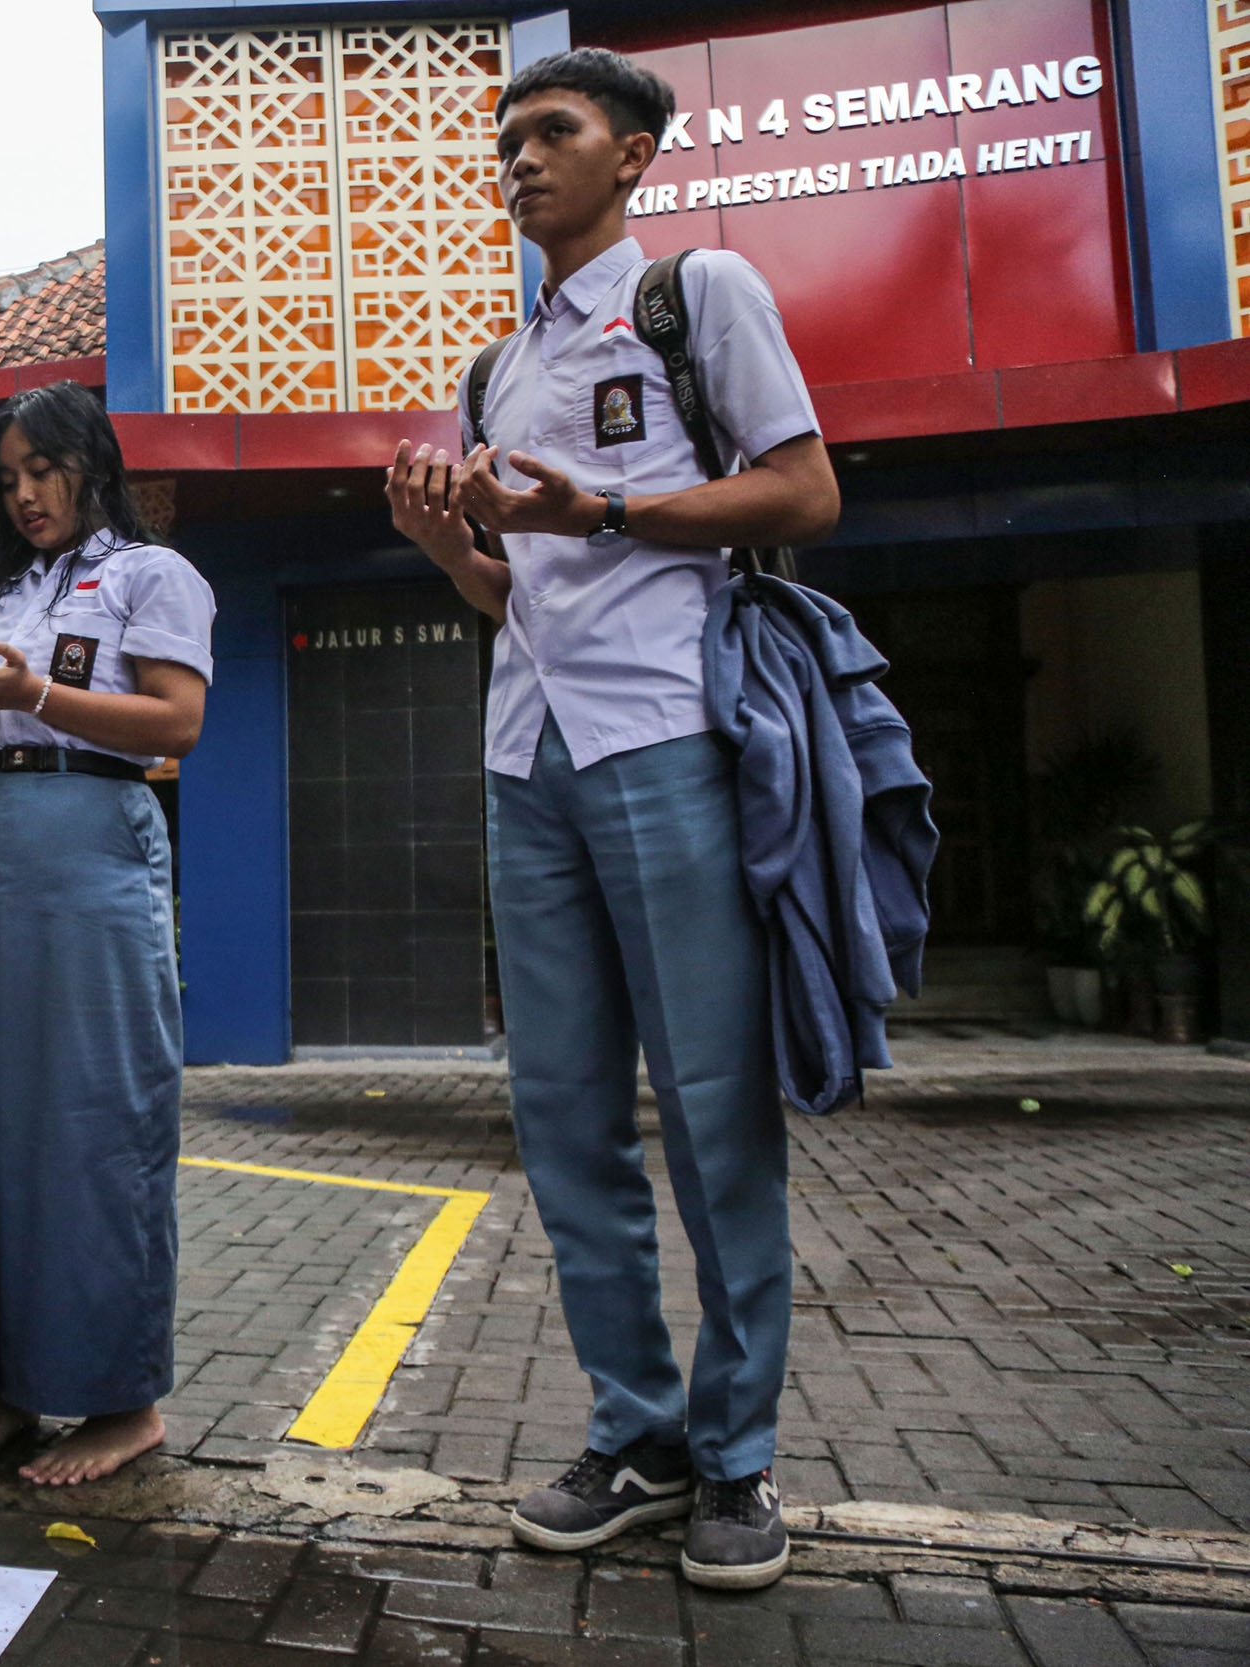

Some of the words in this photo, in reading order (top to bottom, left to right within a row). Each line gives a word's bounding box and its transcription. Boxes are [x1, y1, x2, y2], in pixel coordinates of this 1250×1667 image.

[708, 105, 744, 146] N
[757, 98, 790, 137] 4
[802, 55, 1103, 134] SEMARANG
[626, 183, 679, 220] KIR
[686, 162, 850, 210] PRESTASI
[860, 147, 967, 189] TIADA
[977, 130, 1092, 174] HENTI
[315, 628, 382, 649] JALUR
